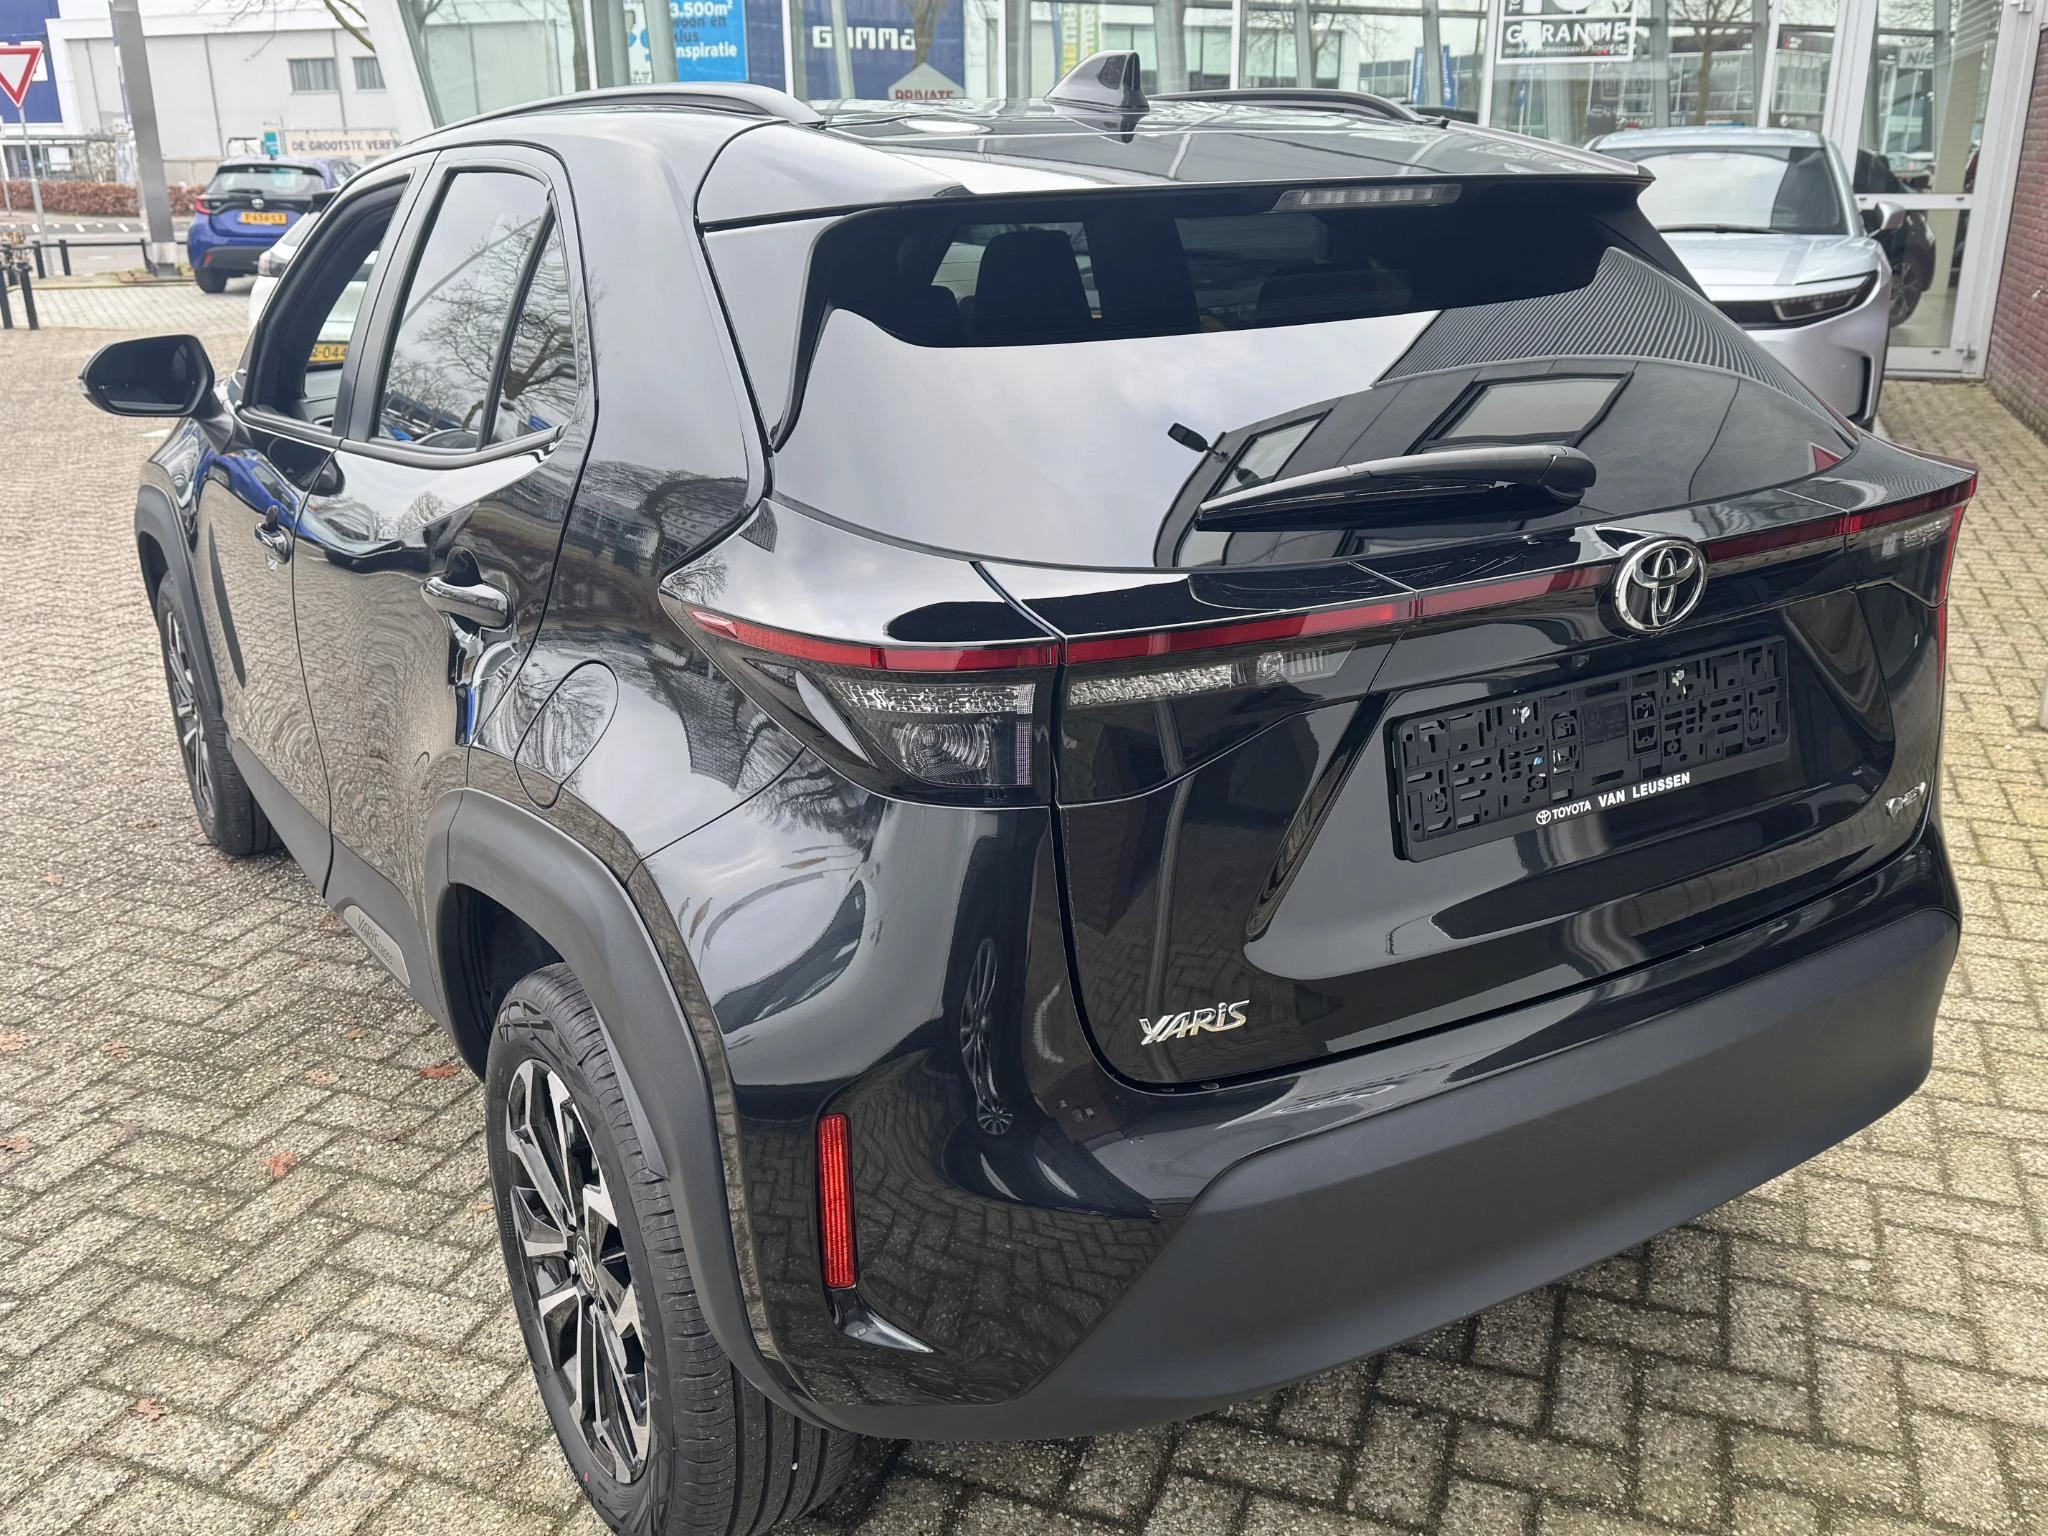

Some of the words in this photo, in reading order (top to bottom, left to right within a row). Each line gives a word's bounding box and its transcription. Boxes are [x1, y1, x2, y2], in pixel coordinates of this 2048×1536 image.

[711, 16, 726, 28] en
[676, 41, 738, 61] nspiratie
[292, 140, 305, 151] DE
[309, 140, 362, 151] GROOTSTE
[1552, 800, 1592, 820] TOYOTA
[1598, 789, 1626, 808] VAN
[1632, 771, 1690, 799] LEUSSEN
